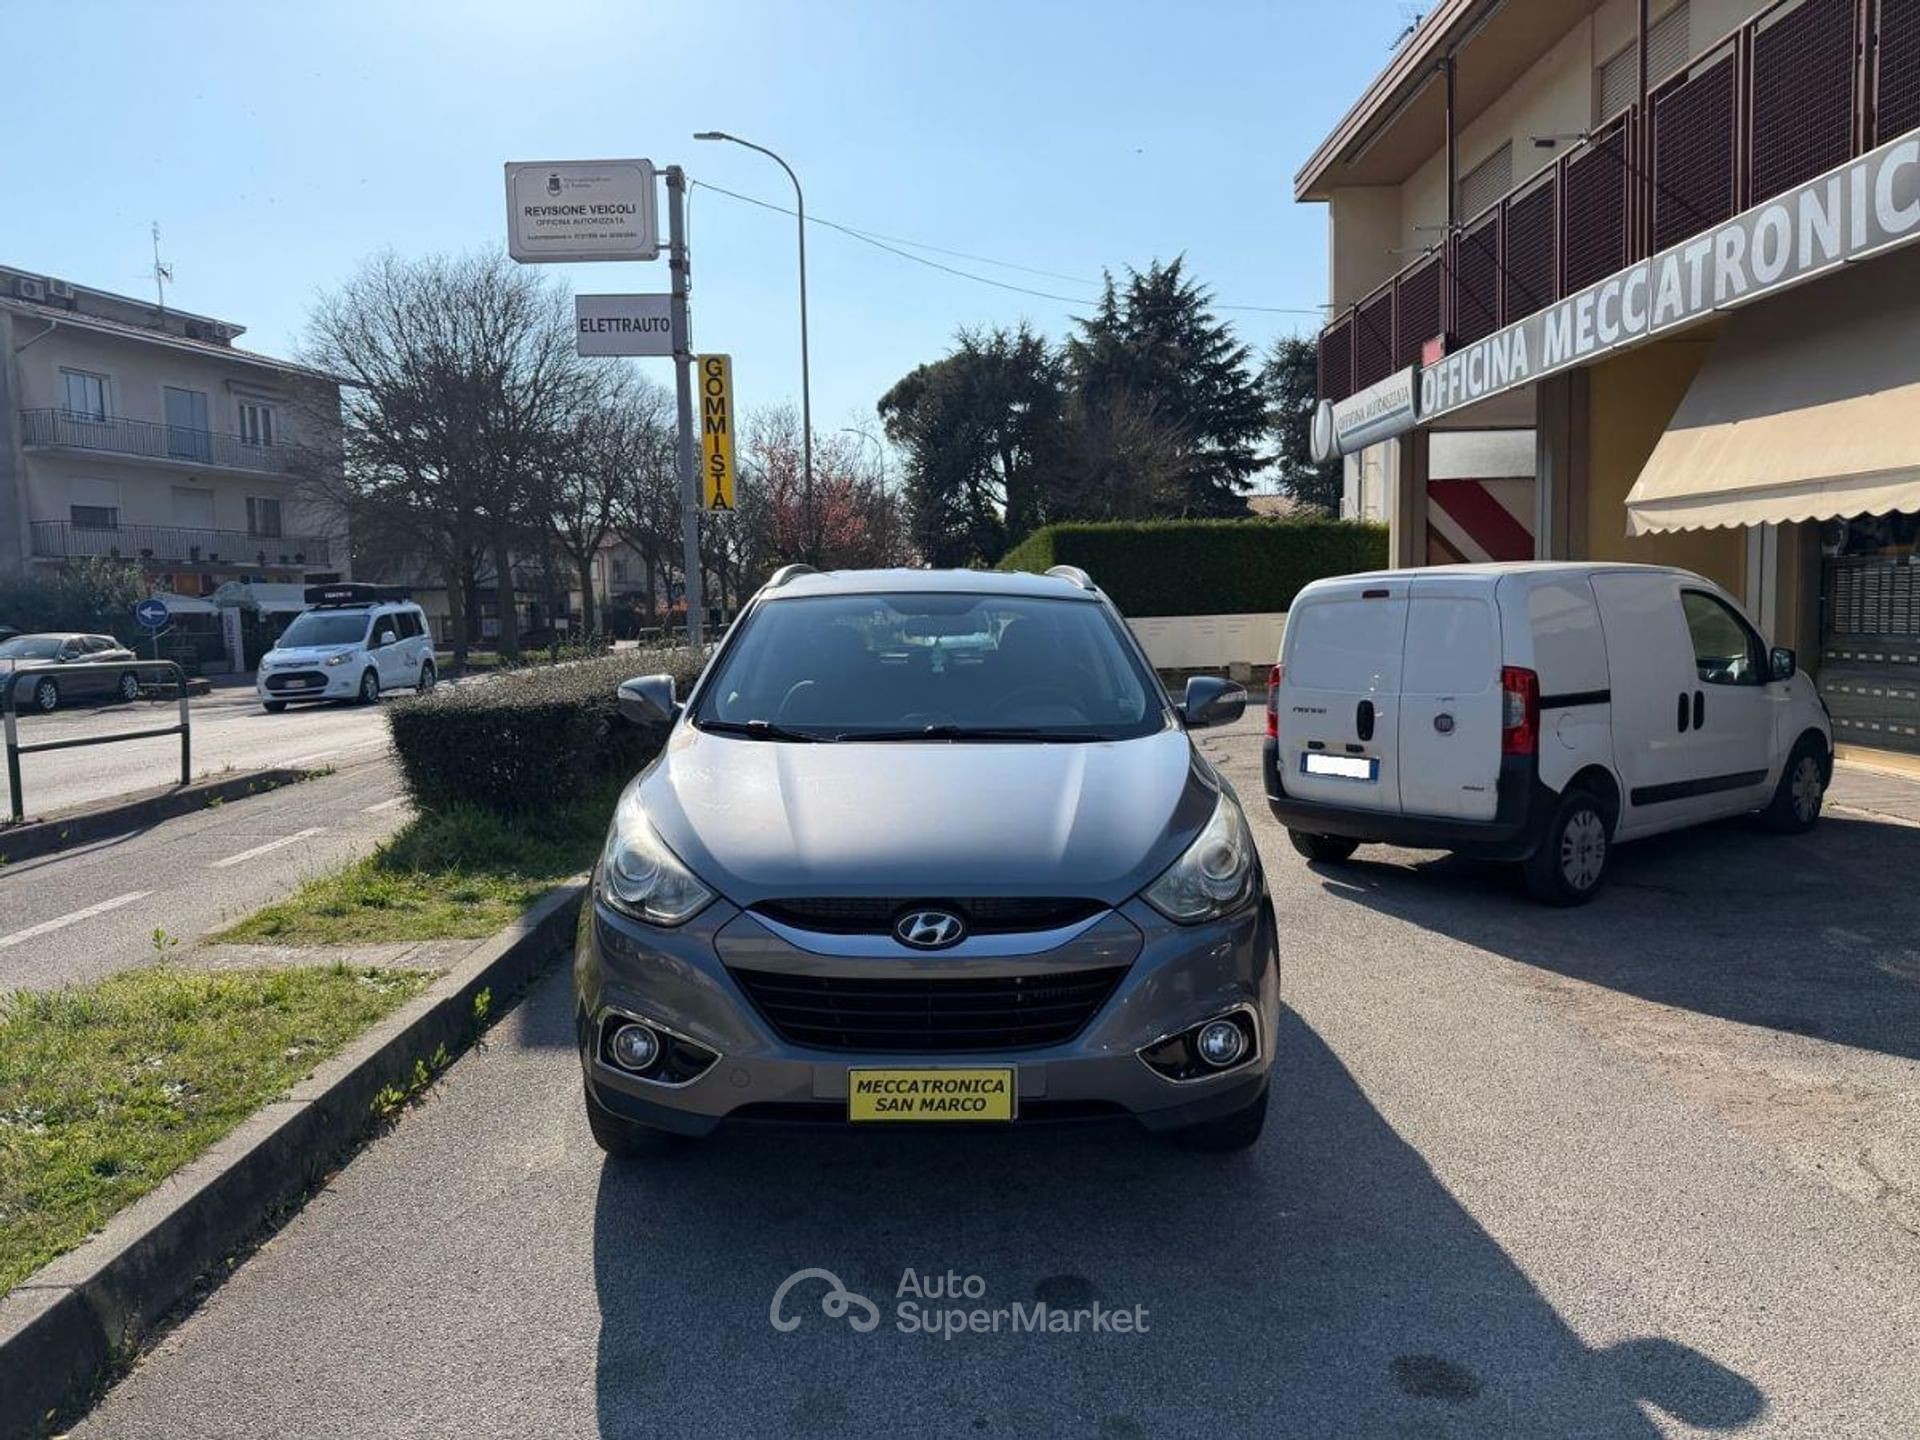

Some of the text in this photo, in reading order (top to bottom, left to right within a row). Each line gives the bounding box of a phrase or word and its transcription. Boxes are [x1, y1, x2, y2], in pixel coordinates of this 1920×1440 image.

[524, 203, 636, 216] REVISIONE VEICOLI
[536, 217, 625, 226] OFFICINA AUTORIZZATA
[580, 318, 670, 333] ELETTRAUTO
[1421, 325, 1529, 415] OFFICINA
[705, 357, 728, 510] GOMMISTA
[856, 1080, 1005, 1094] MECCATRONICA
[875, 1098, 987, 1112] SAN MARCO
